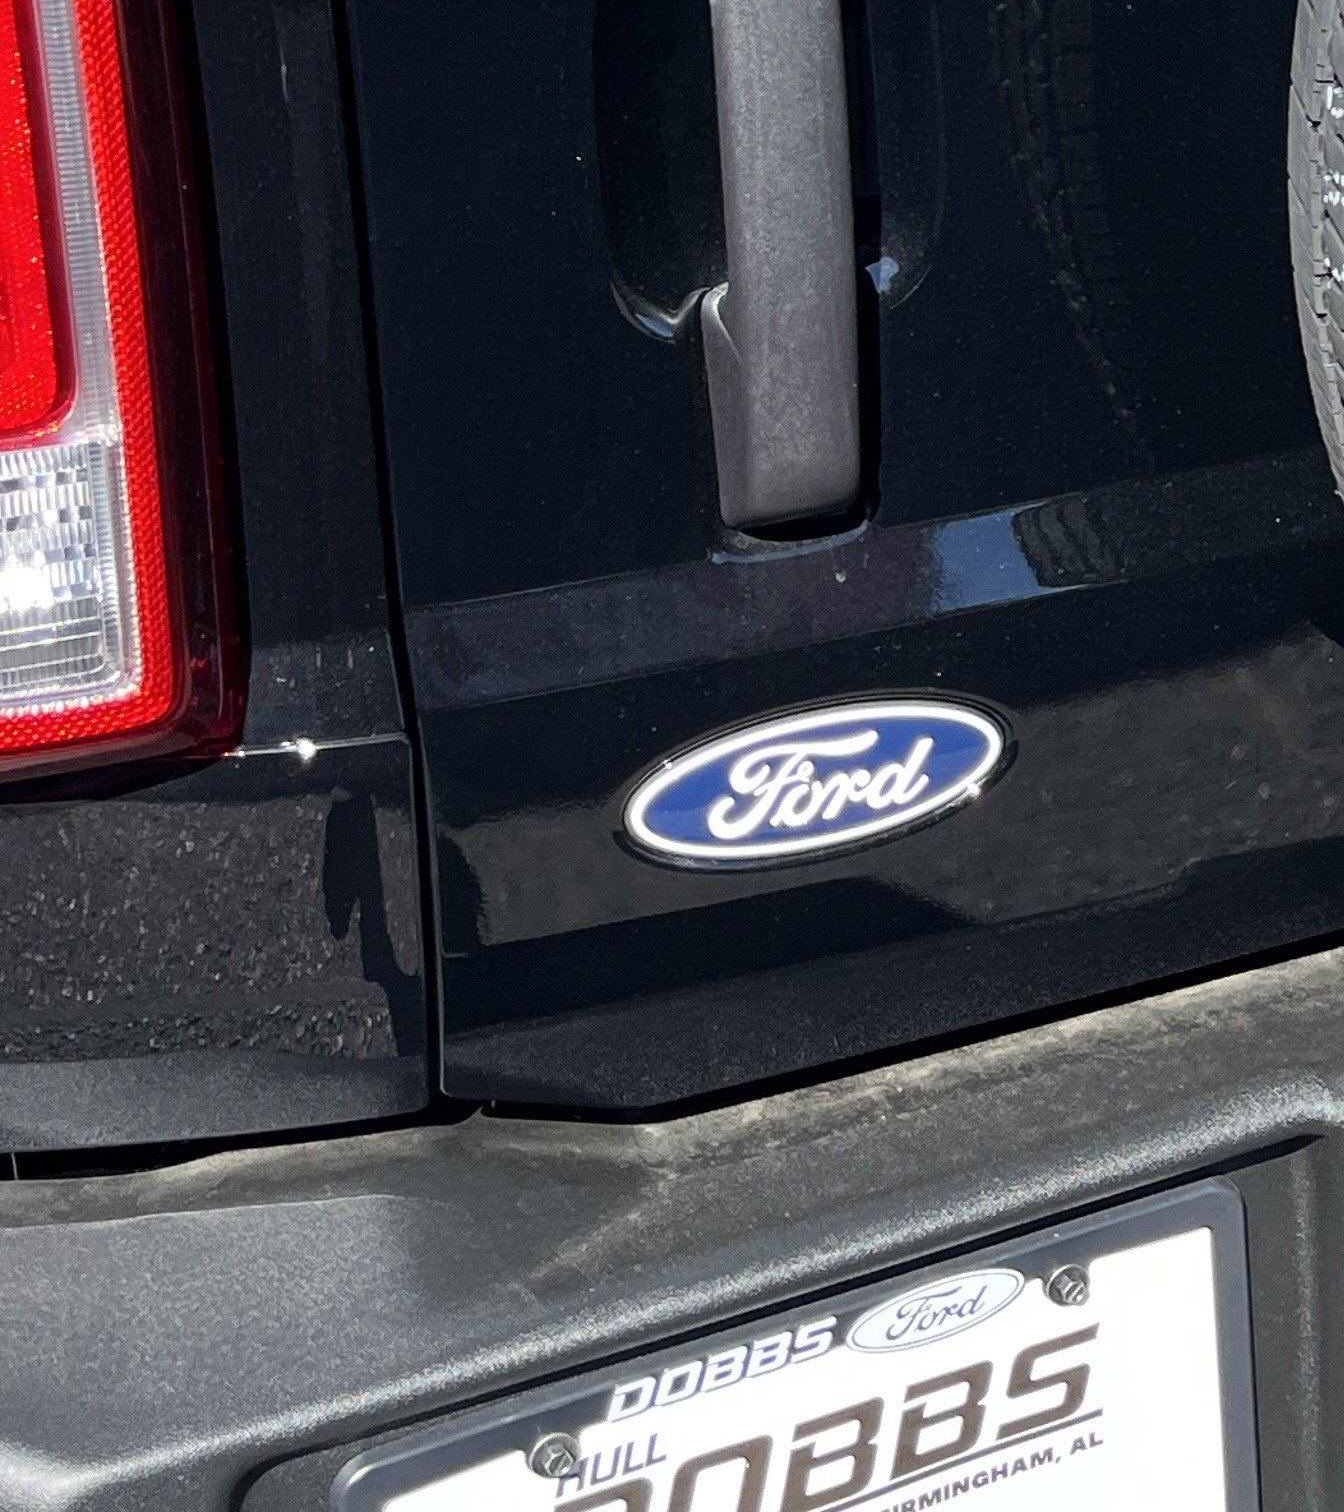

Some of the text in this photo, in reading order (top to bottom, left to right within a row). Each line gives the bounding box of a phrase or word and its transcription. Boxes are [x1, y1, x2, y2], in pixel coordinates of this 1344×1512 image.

[708, 730, 934, 840] Ford
[609, 1287, 991, 1423] DOBBS Ford
[556, 1433, 667, 1498] HULL
[880, 1432, 1103, 1512] IRMINGHAM, AL
